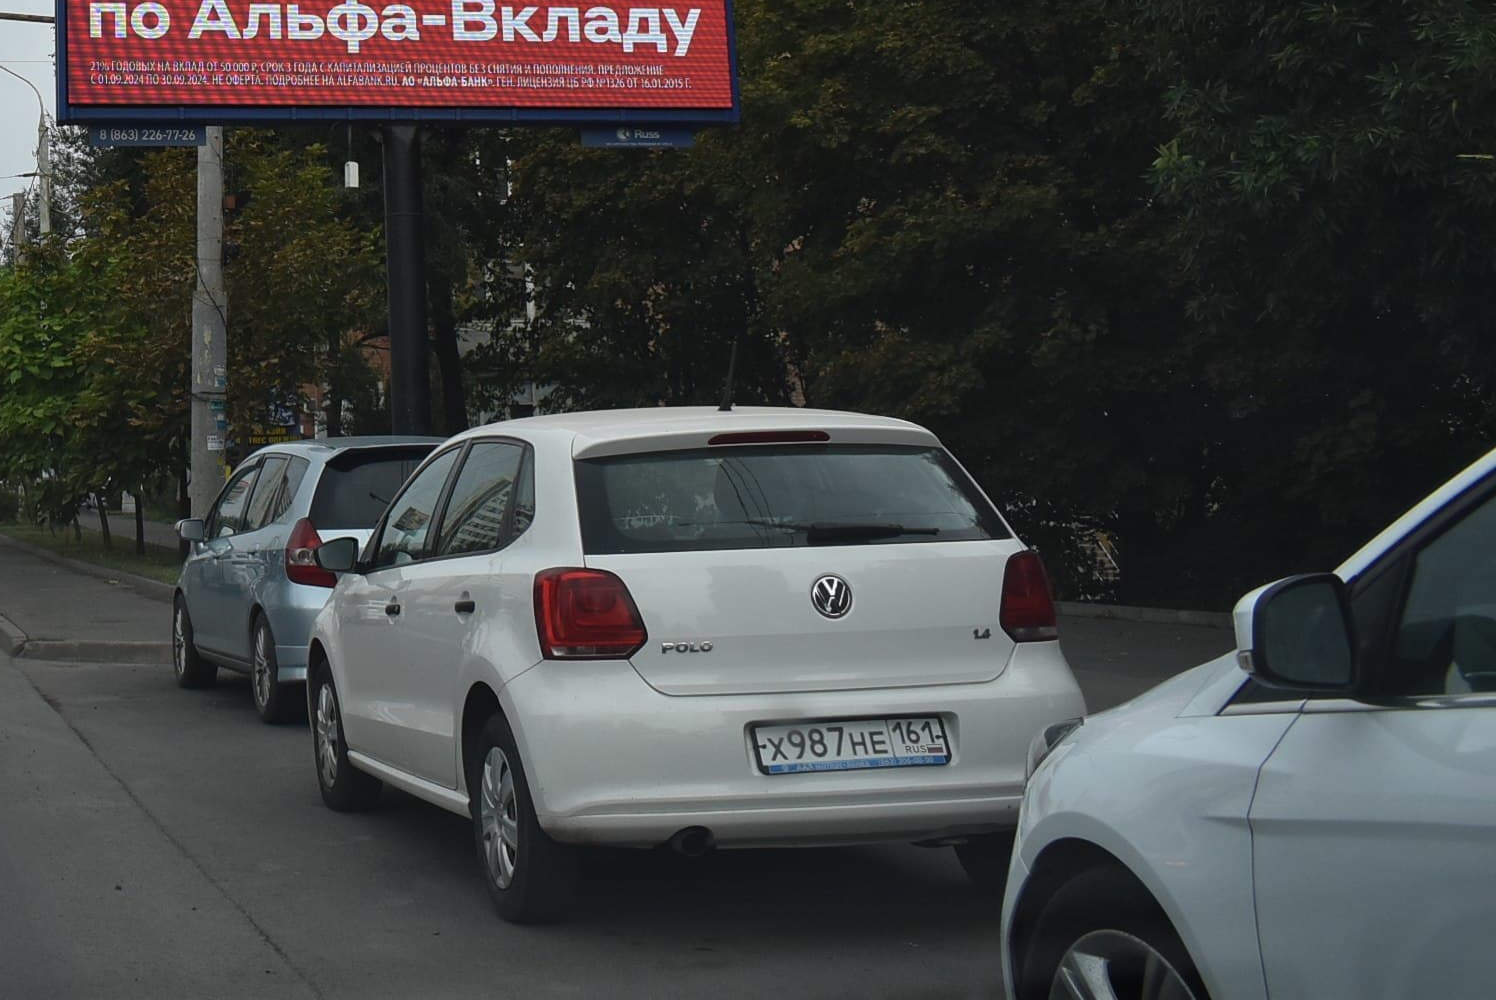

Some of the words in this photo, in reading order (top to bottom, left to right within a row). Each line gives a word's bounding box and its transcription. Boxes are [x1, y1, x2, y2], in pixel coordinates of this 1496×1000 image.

[89, 1, 170, 39] по
[112, 61, 155, 73] ГОДОВЫХ
[158, 61, 170, 71] НА
[173, 61, 204, 73] ВКЛАД
[206, 62, 218, 72] ОТ
[220, 62, 231, 72] 50
[261, 62, 284, 72] СРОК
[294, 62, 317, 74] ГОДА
[319, 62, 325, 72] С
[327, 61, 412, 74] КАПИТАЛИЗАЦИЕЙ
[414, 63, 468, 75] ПРОЦЕНТОВ
[469, 63, 485, 73] БЕЗ
[487, 63, 522, 74] СНЯТИЯ
[598, 64, 664, 76] ПРЕДЛОЖЕНИЕ
[90, 74, 96, 84] С
[98, 74, 144, 85] 01.09.2024
[145, 74, 159, 85] ПО
[212, 74, 224, 85] НЕ
[266, 74, 319, 87] ПОДРОБНЕЕ
[322, 74, 334, 85] НА
[401, 75, 415, 86] АО
[517, 76, 565, 89] ЛИЦЕНЗИЯ
[567, 77, 579, 88] ЦБ
[581, 77, 594, 88] РФ
[627, 77, 638, 88] ОТ
[99, 129, 107, 140] 8
[110, 128, 138, 141] (863)
[142, 129, 196, 141] 226-77-26
[634, 129, 660, 139] Russ
[661, 640, 714, 654] POLO
[767, 726, 889, 761] Х987НЕ
[892, 720, 936, 745] 161
[905, 745, 928, 754] RUS
